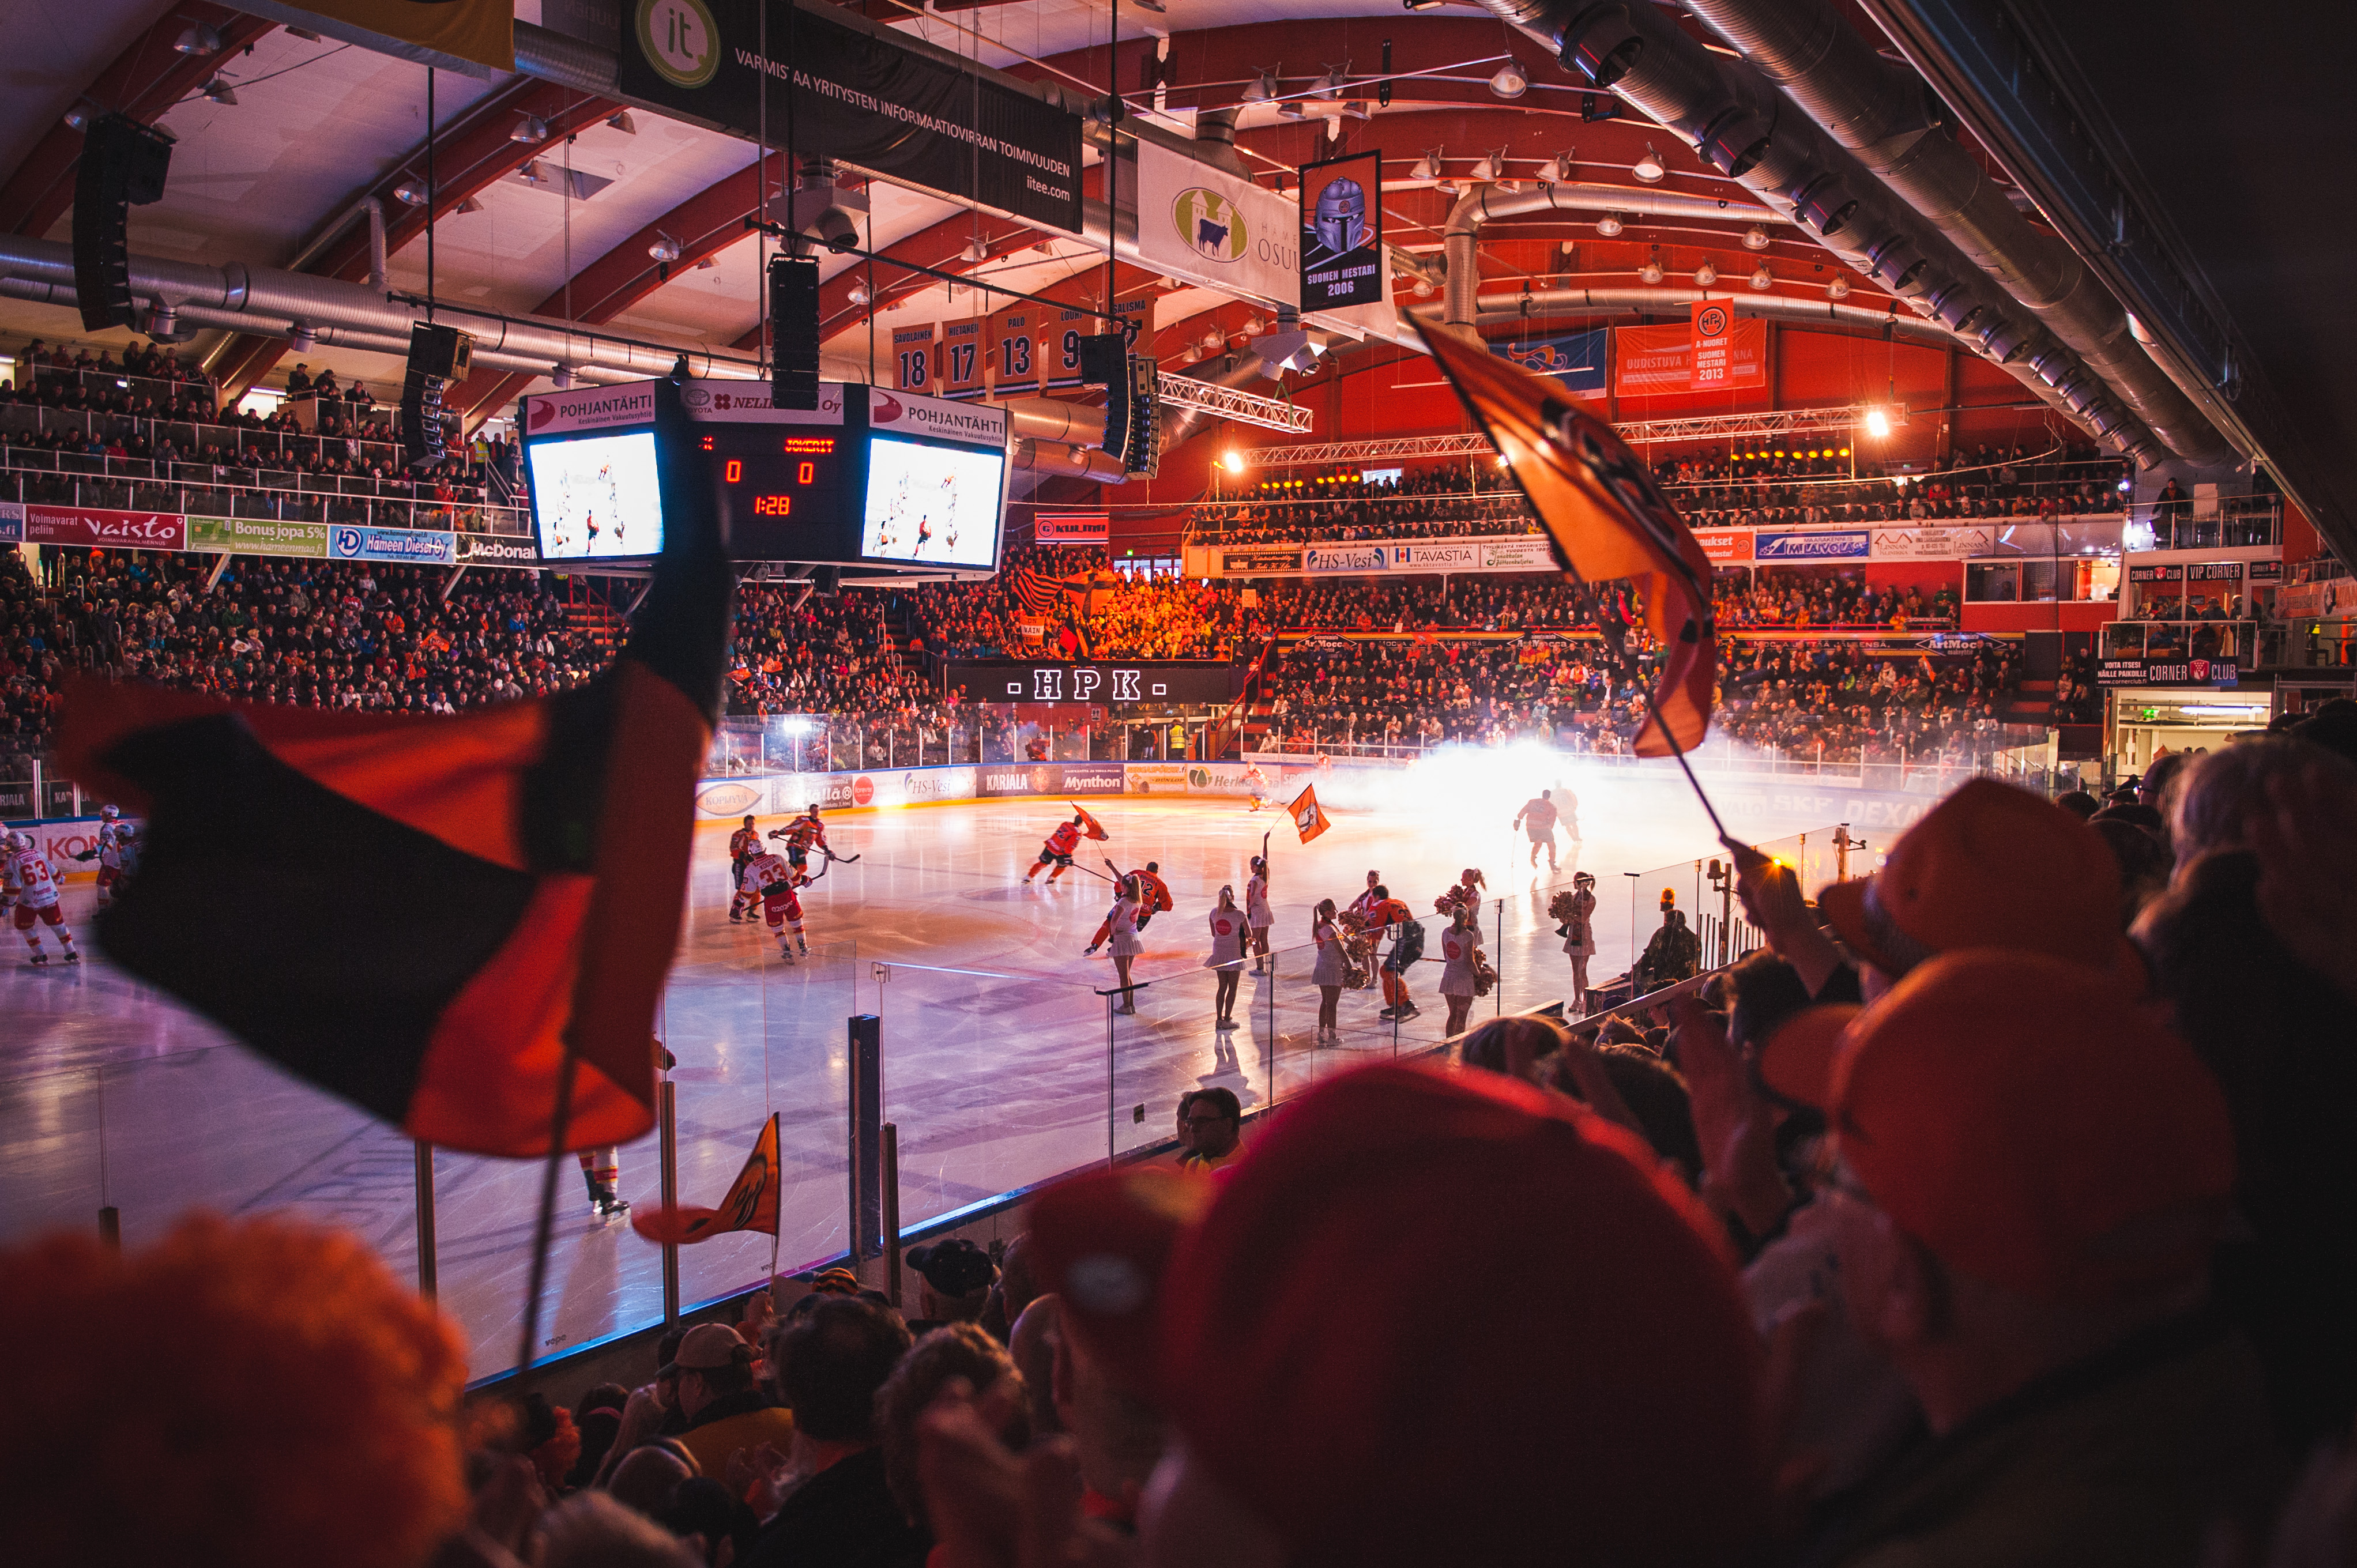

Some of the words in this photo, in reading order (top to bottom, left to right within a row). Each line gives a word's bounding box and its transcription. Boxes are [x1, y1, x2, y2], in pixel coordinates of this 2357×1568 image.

[735, 48, 811, 89] VARMISAA
[814, 76, 878, 112] YRITYSTEN
[881, 100, 997, 152] INFORMAATIOVIRRAN
[999, 141, 1070, 178] TOIMIVUUDEN
[1027, 175, 1070, 202] iitee.com
[1308, 270, 1338, 285] SUOMEN
[1342, 264, 1376, 280] MESTARI
[1328, 281, 1354, 296] 2006
[1113, 300, 1146, 314] SALISMA
[1008, 316, 1025, 329] PALO
[1703, 314, 1722, 330] HPK
[894, 330, 932, 344] SAVOLAINEN
[949, 323, 978, 337] HIETANEN
[1063, 329, 1080, 370] 9
[1696, 337, 1728, 348] A-NUORET
[1002, 336, 1030, 377] 13
[1627, 355, 1682, 369] UUDISTUVA
[1698, 350, 1725, 359] SUOMEN
[900, 349, 926, 389] 18
[950, 342, 976, 383] 17
[1697, 359, 1726, 368] MESTARI
[1699, 368, 1723, 380] 2013
[560, 395, 652, 417] POHJANTÄHTI
[822, 399, 842, 413] Oy
[578, 416, 610, 425] Keskinäinen
[612, 410, 652, 421] Vakuutusyhtiö
[909, 407, 1002, 434] POHJANTÄHTI
[929, 425, 962, 436] Keskinäinen
[964, 432, 1003, 443] Vakuutusyhtiö
[726, 461, 741, 483] 0
[799, 462, 814, 484] 0
[755, 496, 790, 515] 1:28
[0, 509, 20, 519] RS
[30, 513, 78, 526] Voimavarat
[30, 525, 54, 536] peliin
[84, 516, 175, 538] Vaisto
[235, 521, 275, 536] Bonus
[276, 523, 304, 540] jopa
[307, 526, 325, 538] 5%
[97, 537, 166, 545] VOIMAVARAVALMENNUS
[235, 541, 322, 556] www.hameenmaa.fi
[367, 535, 403, 552] Hämeen
[405, 537, 432, 553] Diesel
[434, 539, 447, 557] Oy
[1696, 536, 1733, 546] oukset
[471, 542, 537, 559] McDonal
[1414, 551, 1473, 562] TAVASTIA
[1318, 553, 1372, 568] HS-Vesi
[2131, 570, 2153, 580] CORNER
[2167, 569, 2181, 579] CLUB
[2190, 566, 2203, 579] VIP
[2207, 565, 2240, 579] CORNER
[1928, 640, 1993, 649] ArtMoca
[2150, 665, 2187, 681] CORNER
[2211, 664, 2236, 680] CLUB
[1034, 670, 1140, 700] HPK
[913, 779, 950, 794] HS-Vesi
[987, 774, 1028, 791] KARJALA
[1064, 775, 1120, 790] Mynthon
[0, 794, 25, 806] RJALA
[706, 792, 748, 805] KOPIJYVÄ
[1772, 796, 1833, 813] SKF
[20, 860, 50, 886] 63
[759, 863, 789, 884] 33
[1140, 880, 1153, 897] 12
